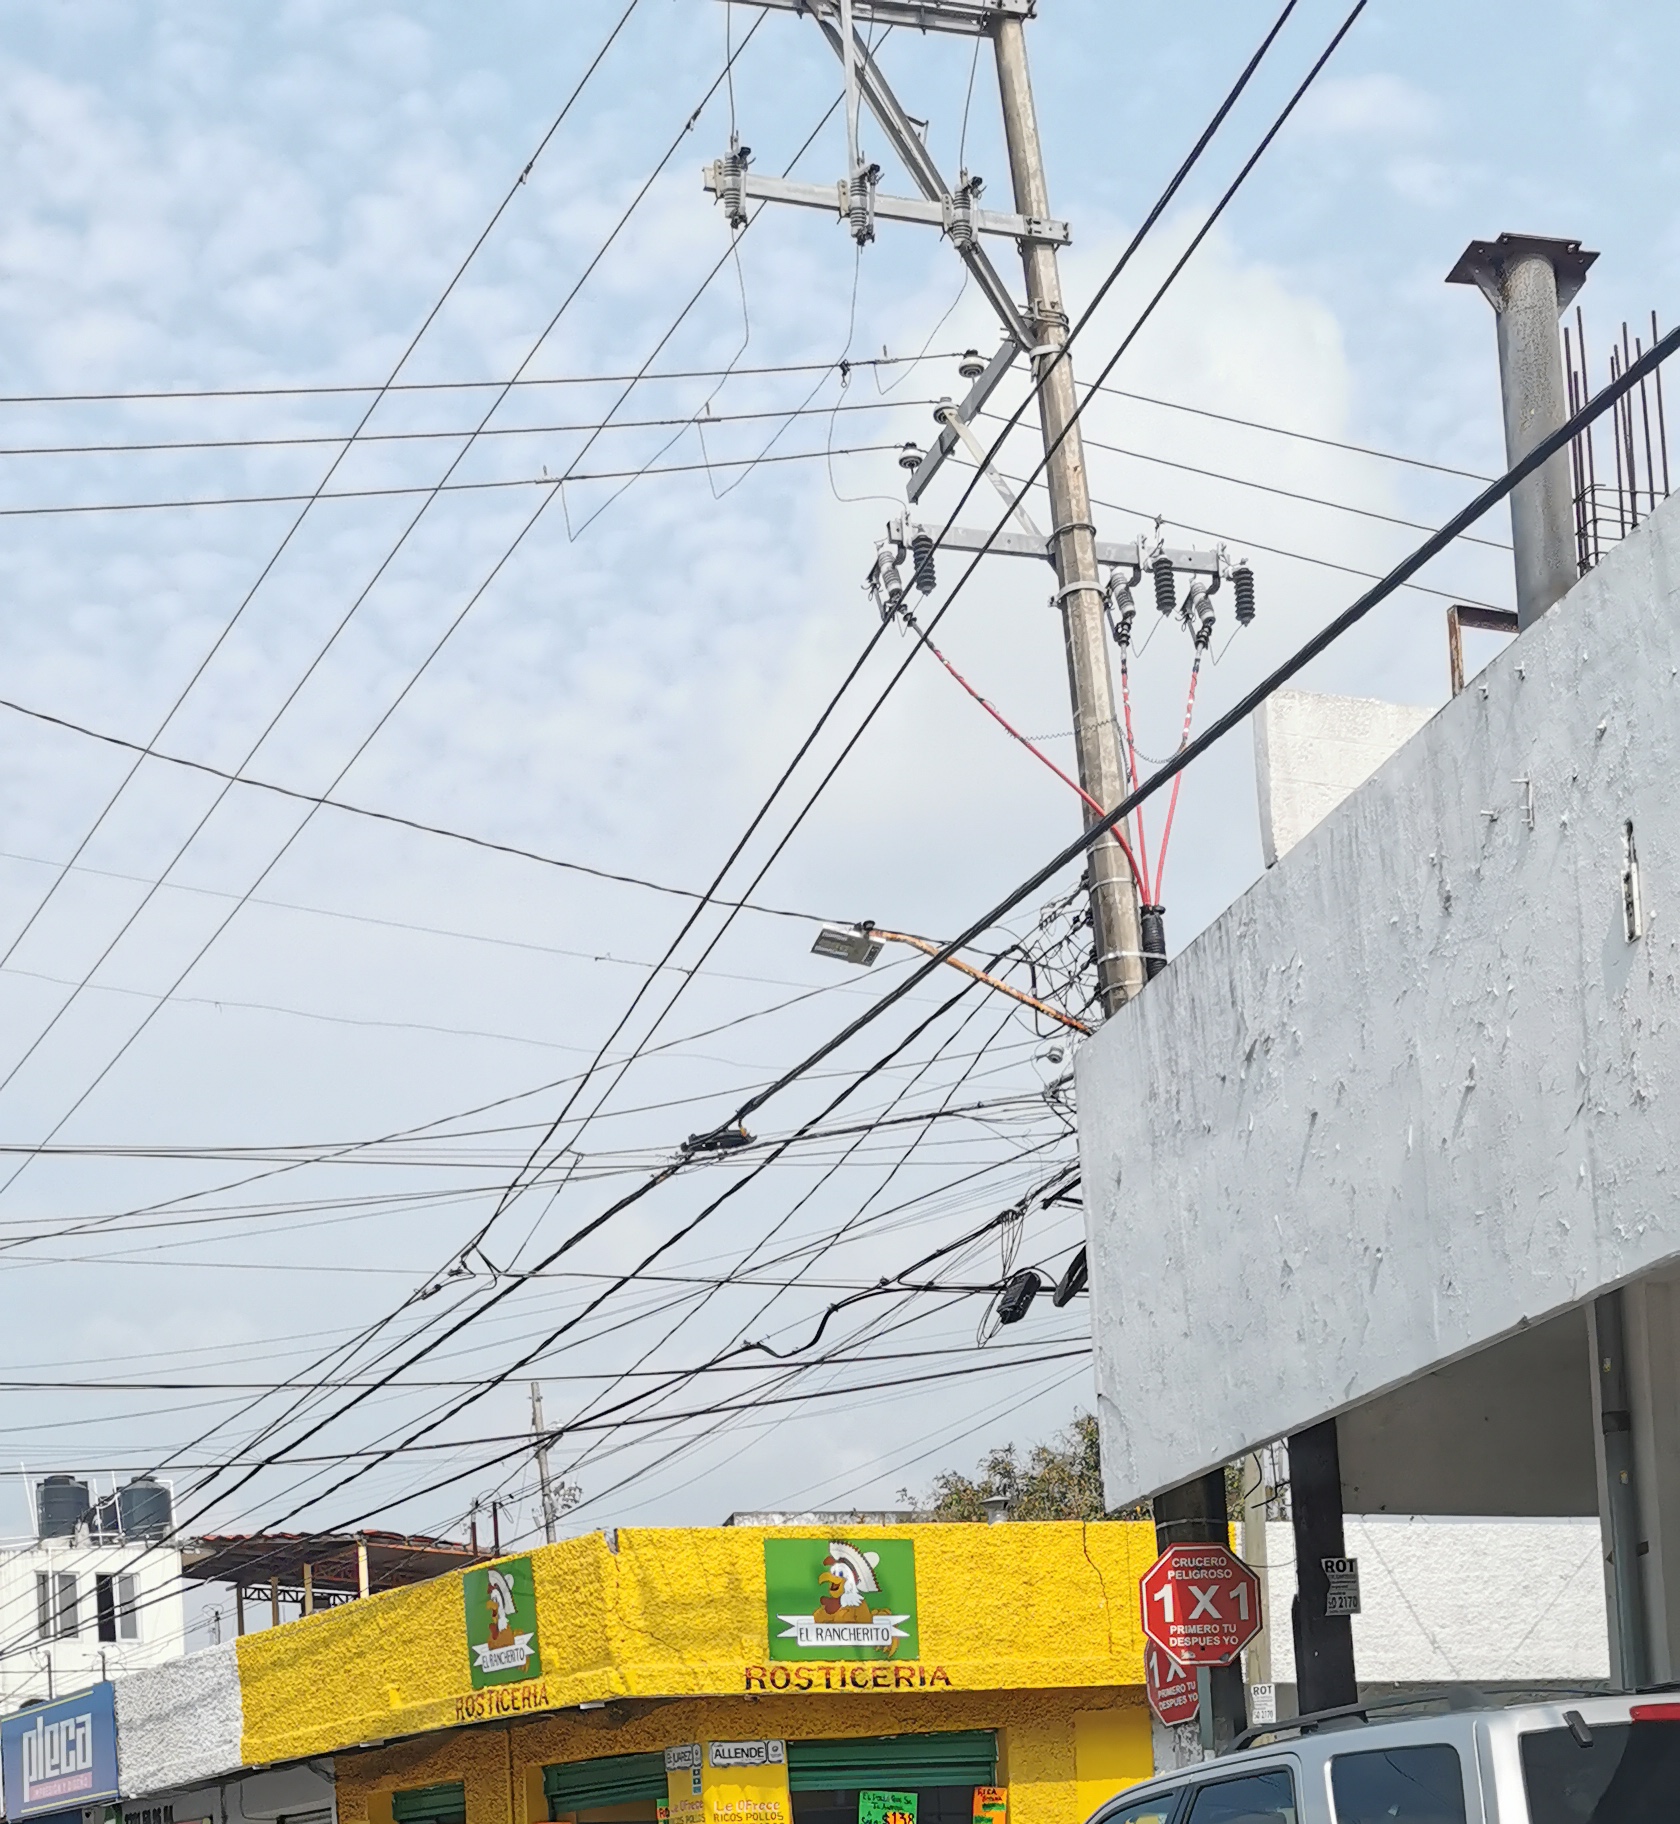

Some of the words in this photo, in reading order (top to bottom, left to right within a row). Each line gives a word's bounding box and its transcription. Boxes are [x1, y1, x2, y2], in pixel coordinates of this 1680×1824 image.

[1172, 1557, 1227, 1567] CRUCERO
[1324, 1560, 1355, 1573] ROT
[1167, 1569, 1233, 1580] PELIGROSO
[1153, 1583, 1175, 1623] 1
[1188, 1585, 1222, 1620] X
[1229, 1582, 1249, 1621] 1
[1338, 1595, 1358, 1609] 2170
[799, 1627, 813, 1642] EL
[815, 1627, 890, 1643] RANCHERITO
[1169, 1624, 1220, 1635] PRIMERO
[1222, 1623, 1237, 1634] TU
[1169, 1636, 1221, 1647] DESPUES
[1222, 1635, 1239, 1645] YO
[482, 1655, 490, 1669] EL
[489, 1647, 526, 1668] RANCHERITO
[744, 1665, 952, 1691] ROSTICERIA
[1157, 1683, 1186, 1699] PRIMERO
[1187, 1681, 1196, 1692] TU
[1253, 1685, 1272, 1696] ROT
[455, 1683, 550, 1721] ROSTICERIA
[1158, 1696, 1187, 1711] DESPUES
[1187, 1692, 1199, 1704] YO
[22, 1712, 93, 1803] pleca
[714, 1747, 765, 1759] ALLENDE
[714, 1800, 734, 1813] Le
[713, 1812, 743, 1823] RICOS
[746, 1811, 784, 1821] POLLOS
